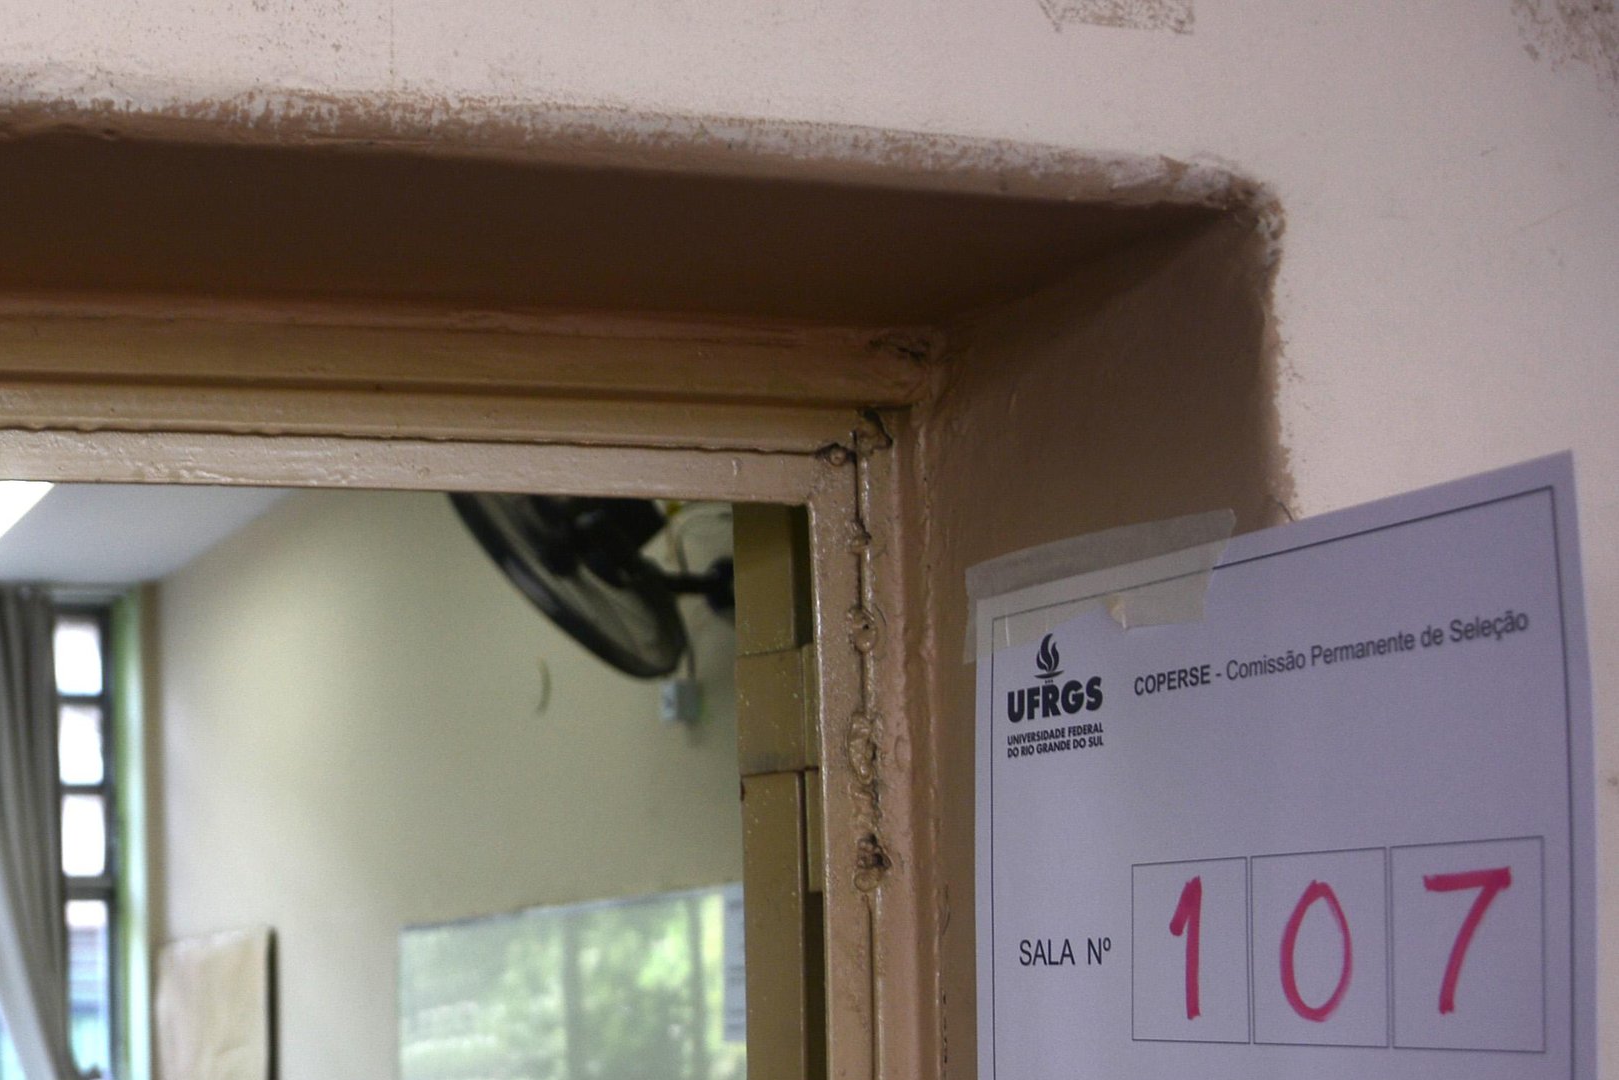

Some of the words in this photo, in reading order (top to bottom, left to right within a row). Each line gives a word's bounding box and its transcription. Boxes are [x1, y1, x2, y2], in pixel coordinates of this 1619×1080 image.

[1133, 664, 1211, 696] COPERSE
[1226, 650, 1306, 681] Comissão
[1310, 631, 1416, 667] Permanente
[1420, 624, 1444, 649] de
[1449, 609, 1530, 643] Seleção
[1007, 675, 1103, 723] UFRGS
[1007, 727, 1066, 746] UNIVERSIDADE
[1068, 721, 1104, 738] FEDERAL
[1007, 746, 1020, 758] DO
[1021, 744, 1035, 757] RIO
[1036, 739, 1072, 754] GRANDE
[1073, 737, 1086, 749] DO
[1088, 735, 1104, 748] SUL
[1019, 938, 1076, 966] SALA
[1087, 936, 1112, 965] Nº
